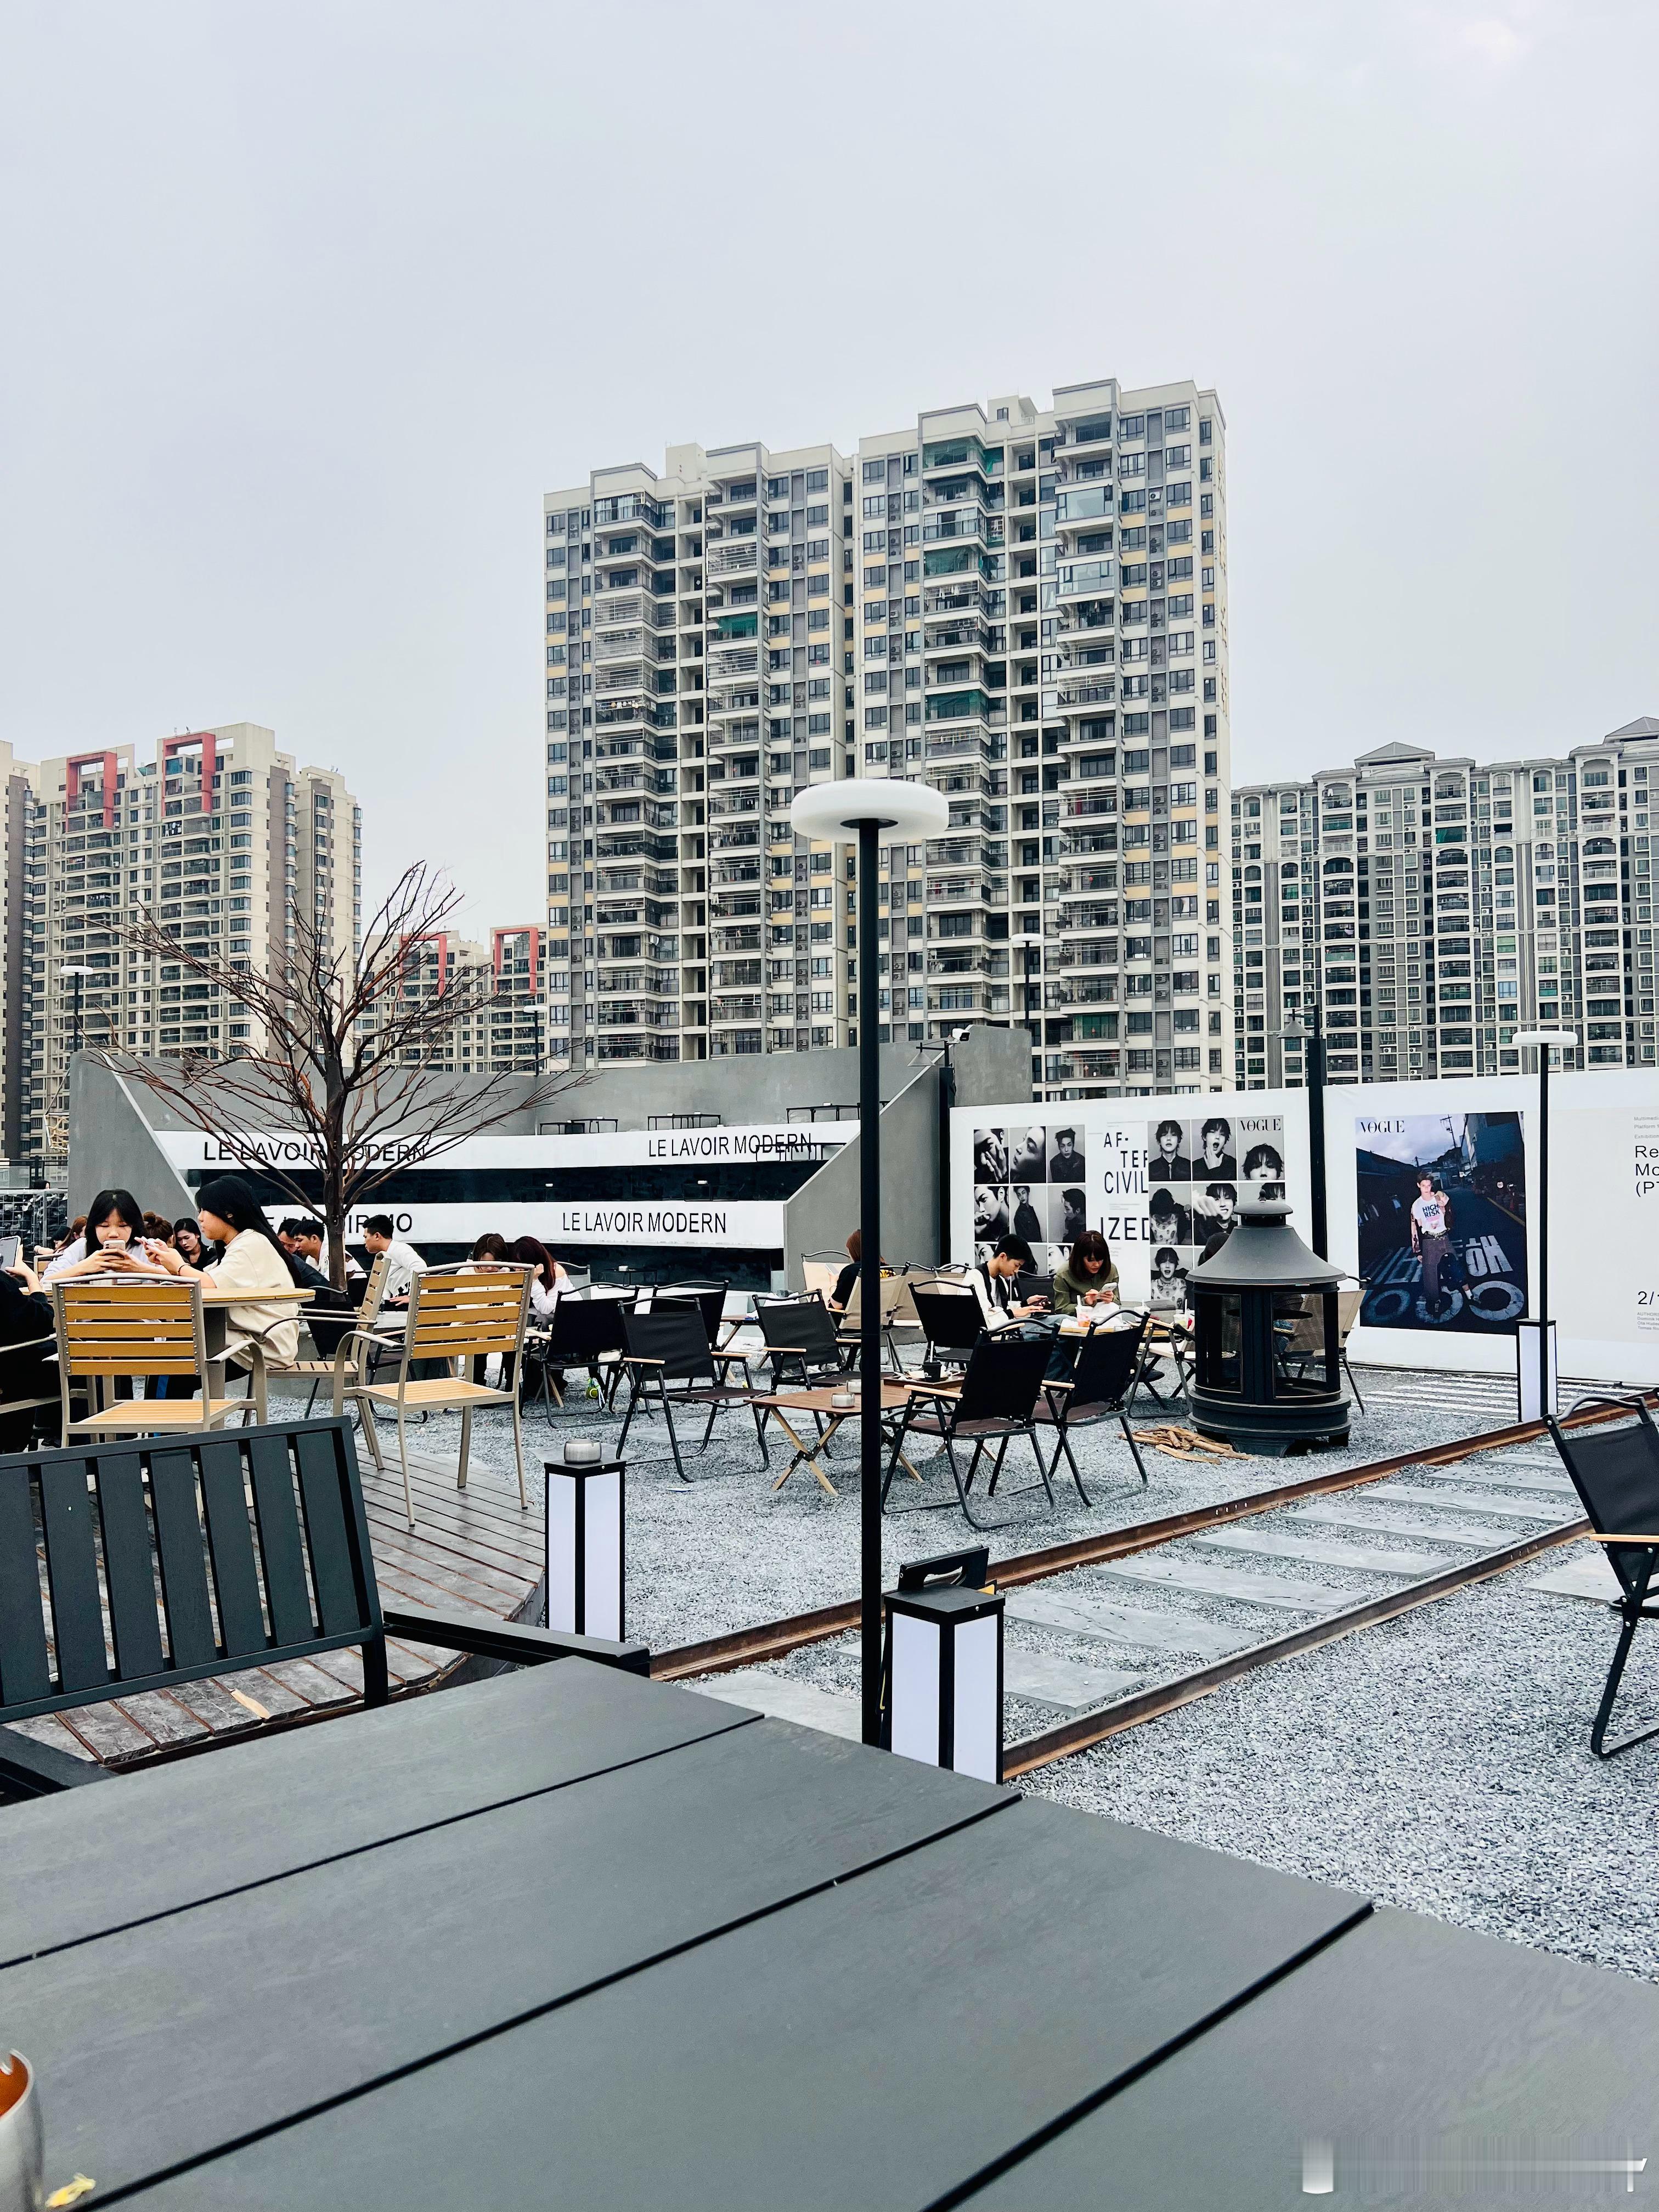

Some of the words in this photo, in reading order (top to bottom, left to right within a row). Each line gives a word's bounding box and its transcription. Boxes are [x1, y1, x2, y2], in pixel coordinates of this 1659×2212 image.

[1240, 1119, 1281, 1132] VOGUE
[1361, 1120, 1404, 1133] VOGUE
[649, 1139, 667, 1157] LE
[672, 1137, 730, 1156] LAVOIR
[735, 1132, 811, 1154] MODERN
[204, 1142, 236, 1160] LE
[240, 1142, 326, 1161] LAVOIR
[342, 1143, 426, 1162] ODERN
[1635, 1146, 1658, 1158] Re
[1104, 1171, 1148, 1194] CIVIL
[1422, 1204, 1440, 1213] HIGH
[1424, 1209, 1440, 1218] RISK
[563, 1213, 580, 1231] LE
[585, 1212, 643, 1232] LAVOIR
[648, 1212, 726, 1233] MODERN
[1638, 1291, 1659, 1305] 2/
